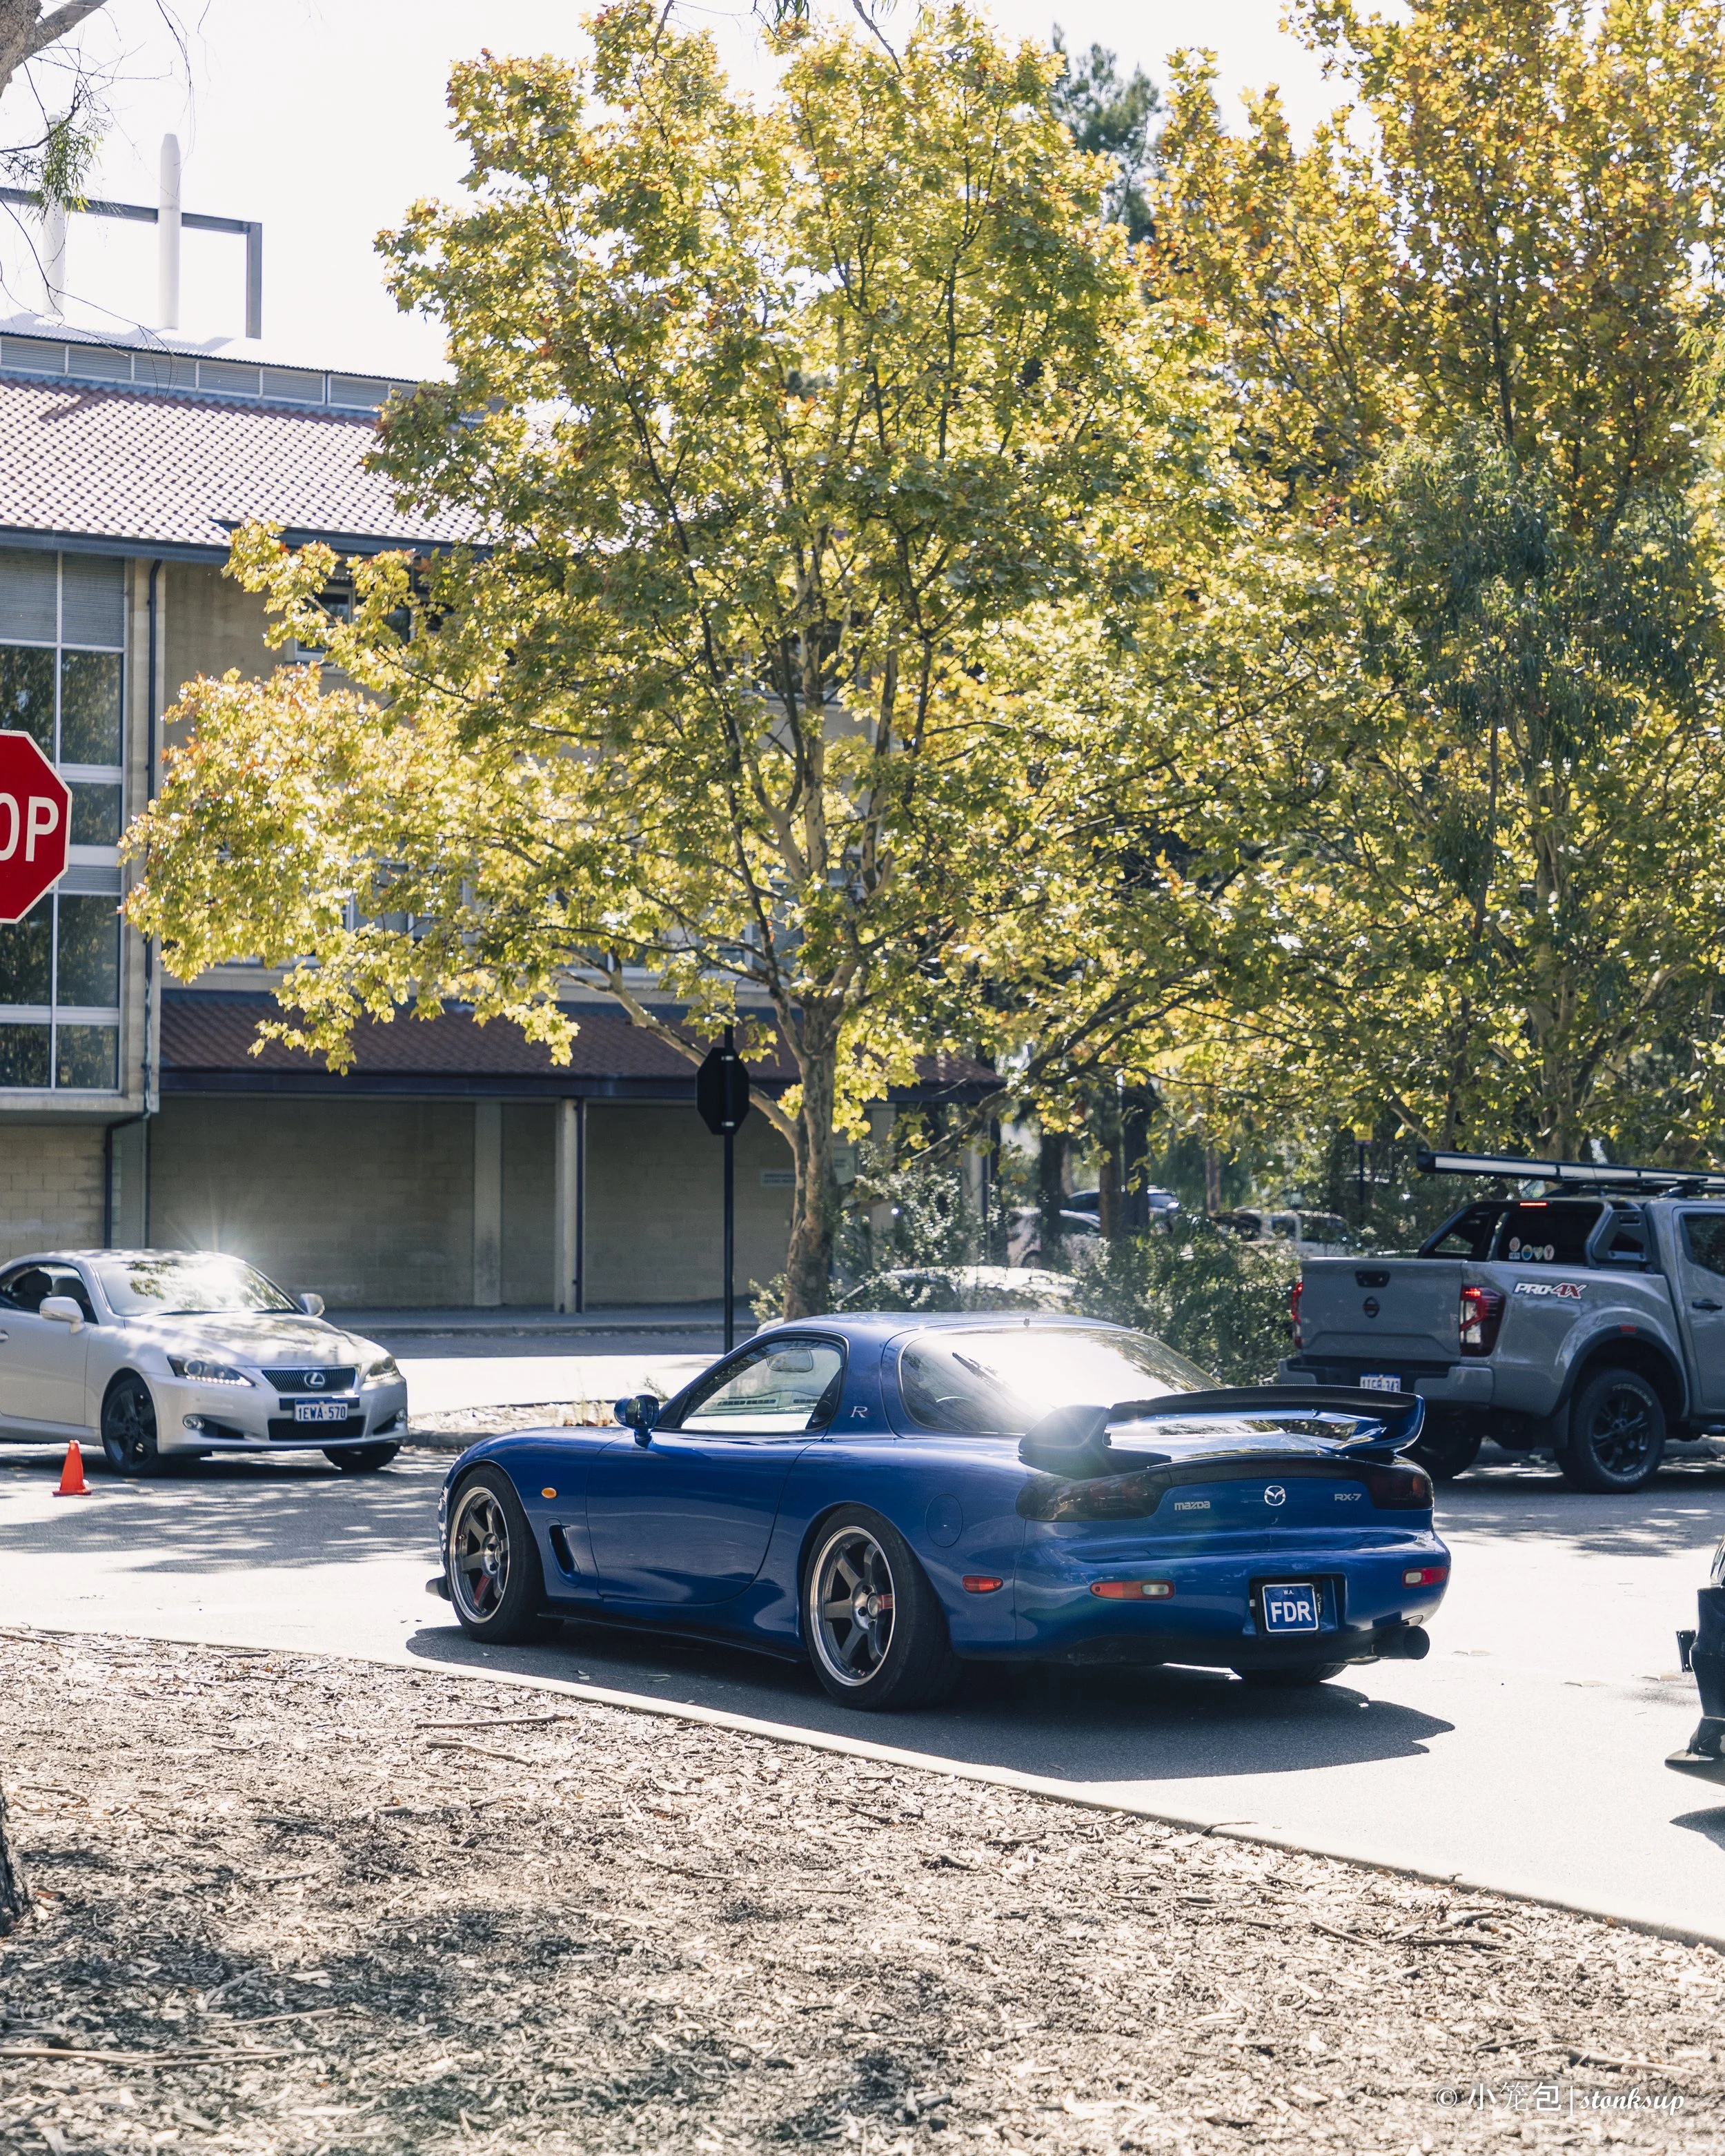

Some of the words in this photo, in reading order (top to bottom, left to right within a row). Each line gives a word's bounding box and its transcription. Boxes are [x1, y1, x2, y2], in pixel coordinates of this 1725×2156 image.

[1514, 1282, 1587, 1299] PRO-4X
[850, 1405, 868, 1418] R
[1334, 1493, 1362, 1501] RX-7
[1270, 1601, 1312, 1623] FDR
